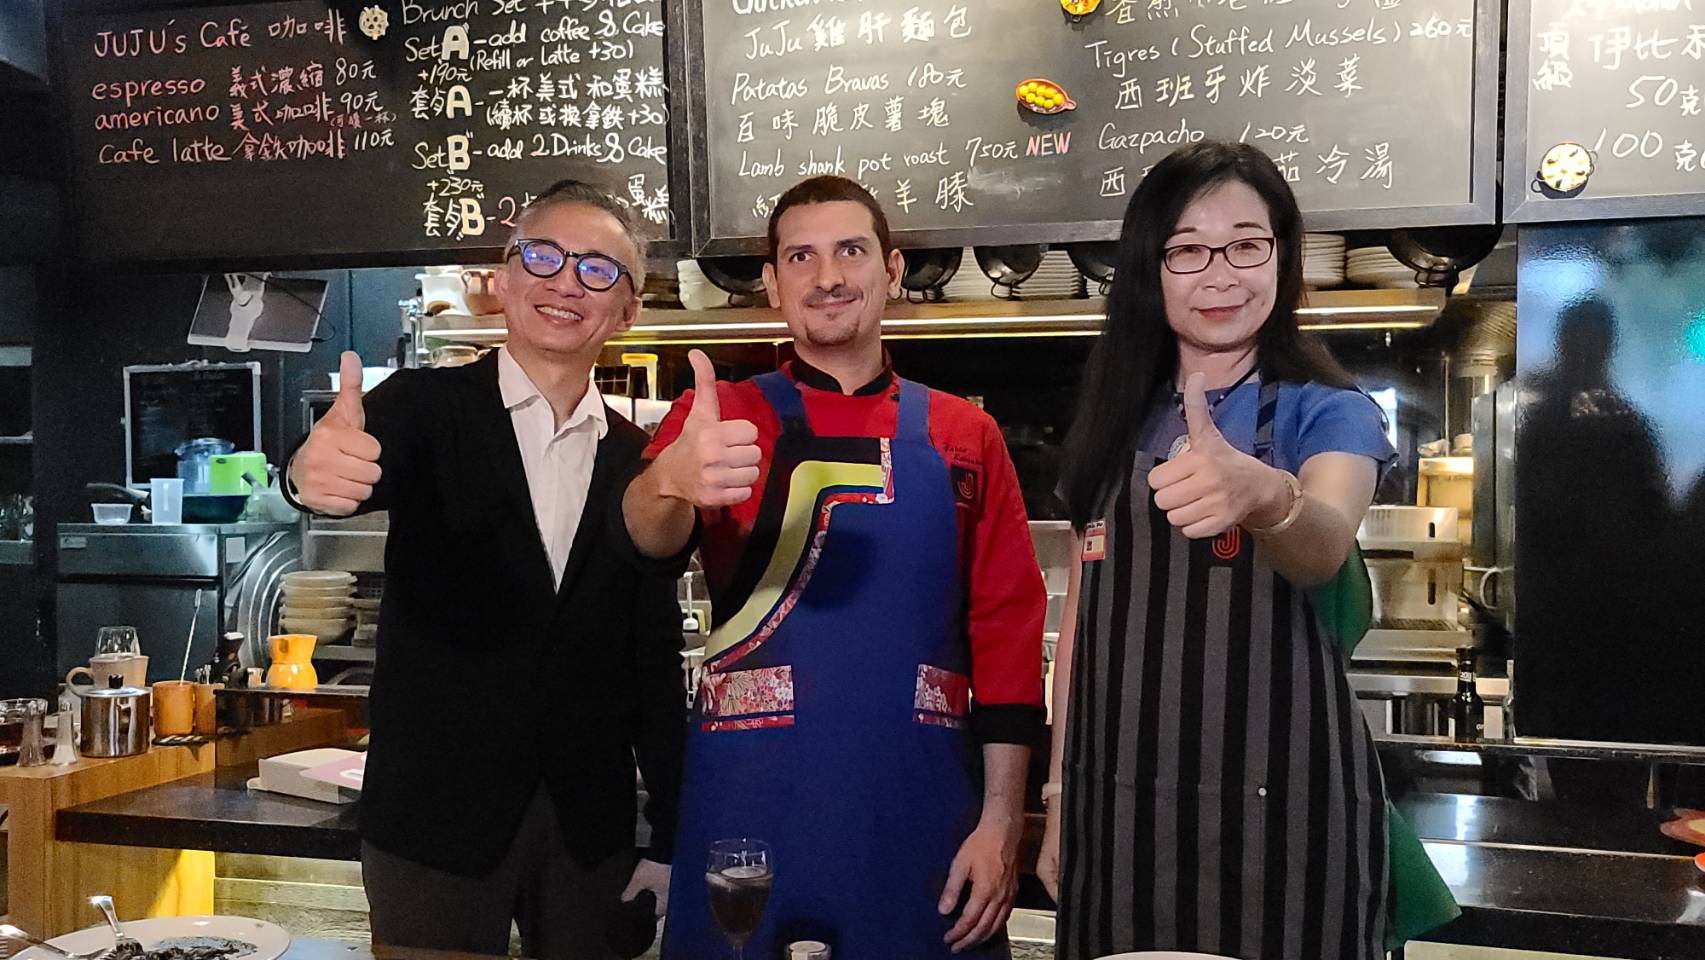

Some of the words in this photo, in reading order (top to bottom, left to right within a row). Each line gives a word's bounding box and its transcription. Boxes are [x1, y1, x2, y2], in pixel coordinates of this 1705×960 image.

[268, 8, 347, 45] 咖啡
[540, 16, 591, 43] coffee
[622, 10, 665, 37] Cake
[516, 57, 534, 67] or
[541, 43, 581, 66] latte
[1085, 39, 1161, 78] Tigres
[91, 78, 206, 107] espresso
[335, 57, 377, 86] 80元
[731, 72, 808, 105] Patatas
[95, 104, 220, 131] americano
[340, 91, 385, 115] 90元
[172, 134, 233, 164] latte
[354, 128, 396, 151] 110元
[550, 132, 602, 157] Drinks
[627, 136, 669, 165] Cake
[1098, 118, 1206, 153] Gazpacho
[737, 150, 785, 177] Lamb
[798, 145, 846, 175] shank
[857, 152, 892, 180] pot
[902, 142, 950, 166] roast
[1024, 131, 1072, 157] NEW
